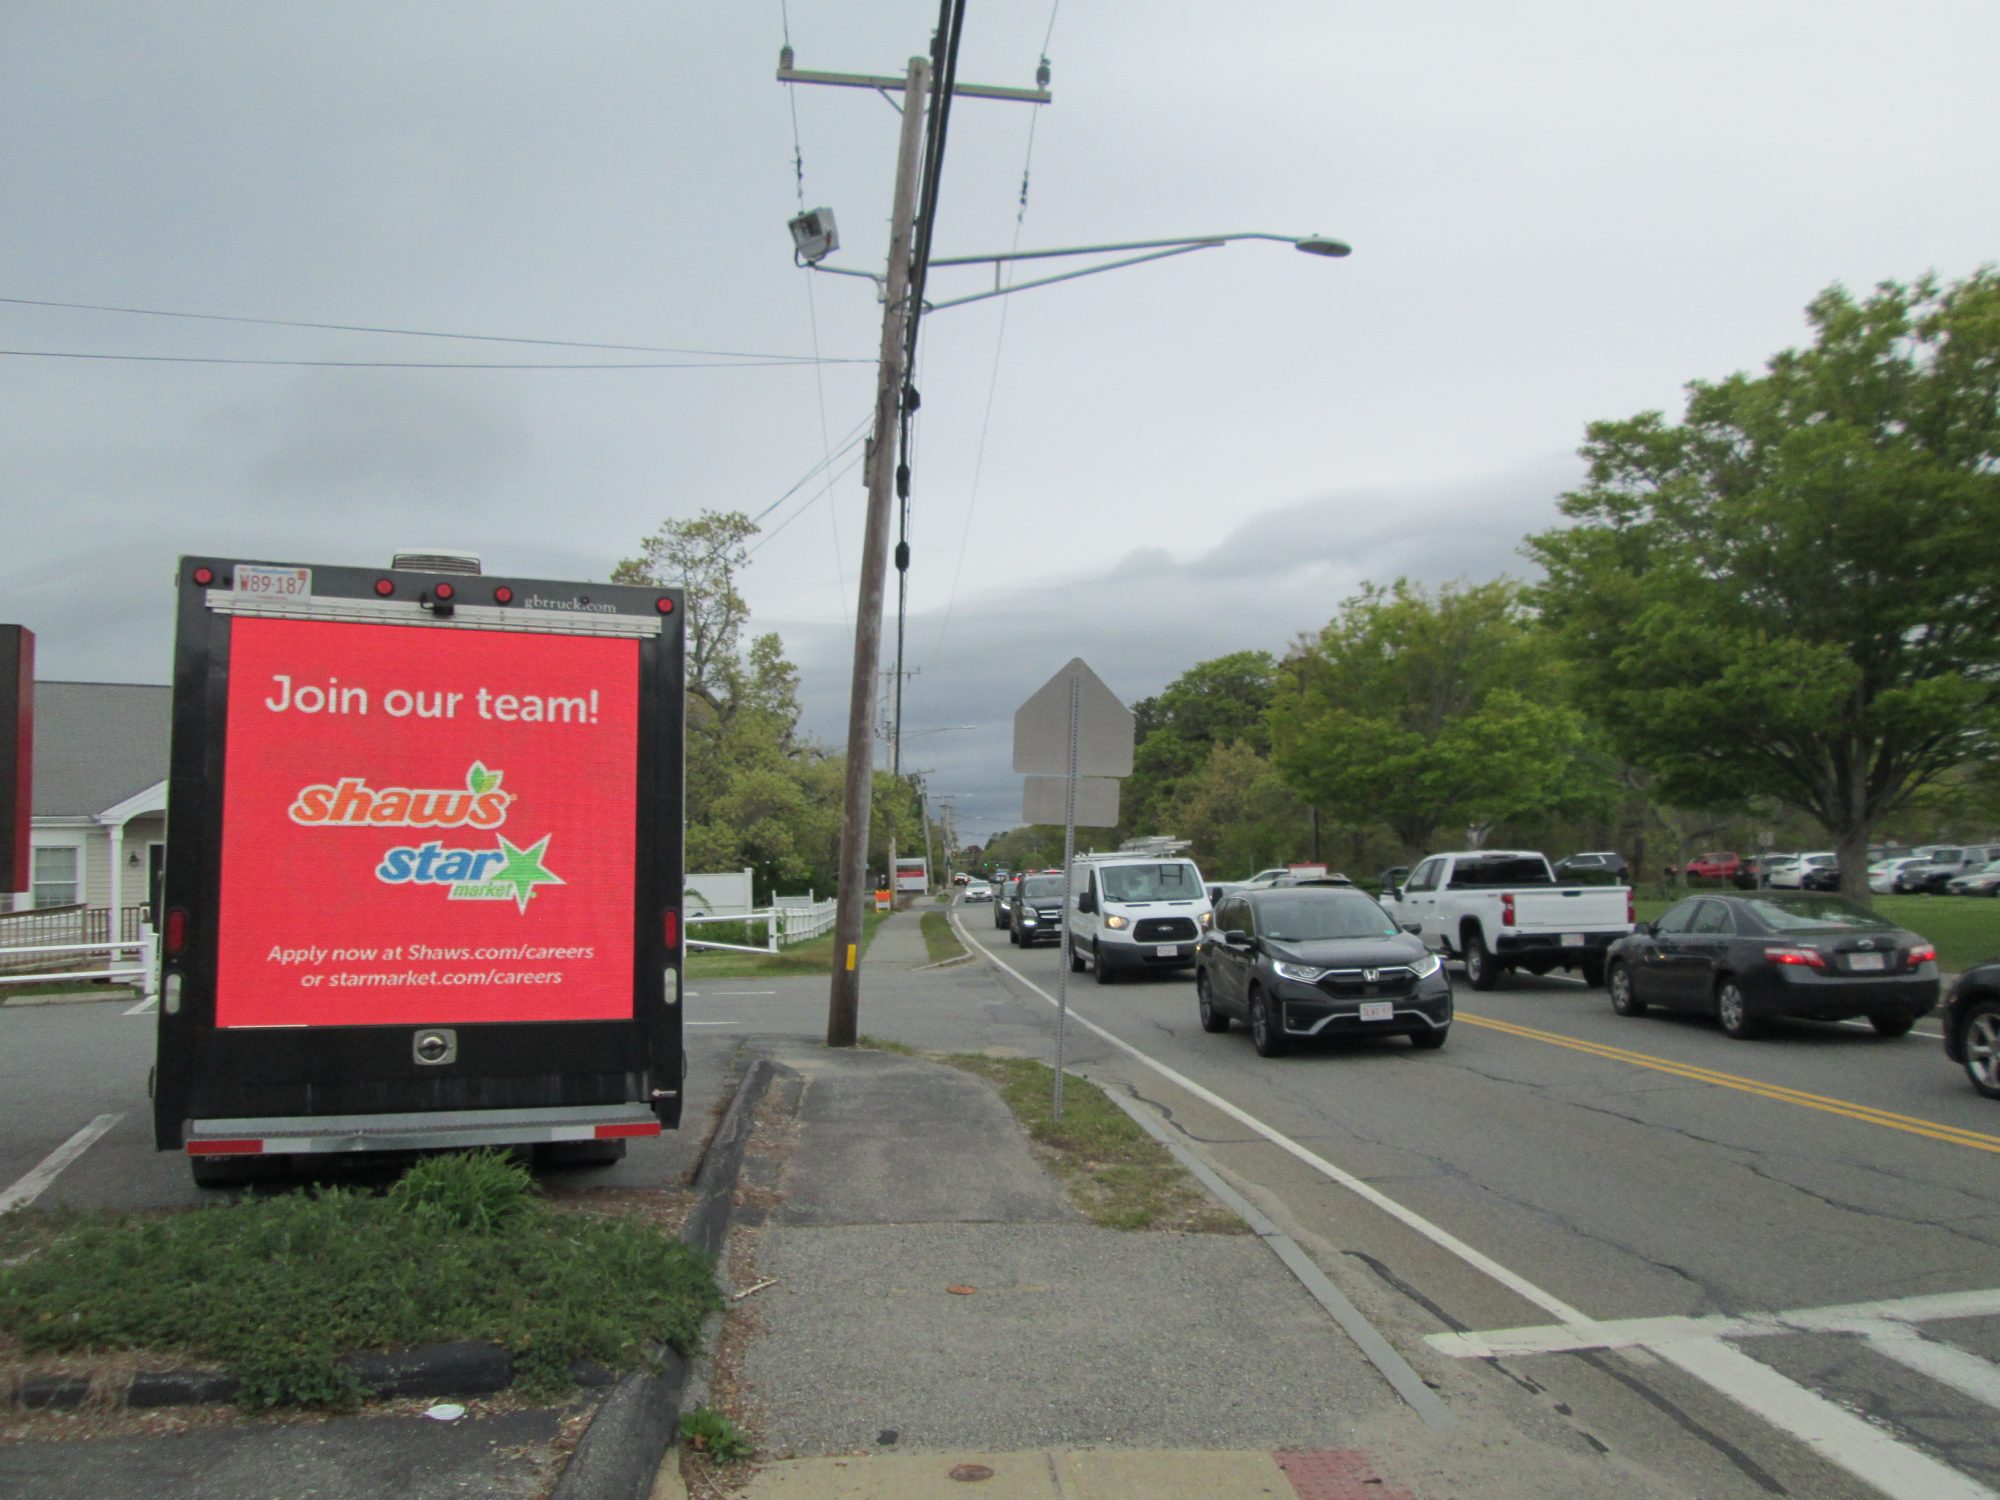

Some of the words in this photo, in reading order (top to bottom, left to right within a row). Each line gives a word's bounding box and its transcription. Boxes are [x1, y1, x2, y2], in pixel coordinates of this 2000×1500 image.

[265, 675, 368, 715] Join
[383, 687, 463, 719] our
[476, 687, 598, 723] team!
[375, 841, 505, 884] star
[452, 882, 513, 897] market
[267, 945, 328, 965] Apply
[332, 947, 377, 962] now
[381, 945, 403, 961] at
[408, 944, 595, 961] Shaws.com/careers
[301, 973, 323, 988] or
[329, 969, 563, 987] starmarket.com/careers
